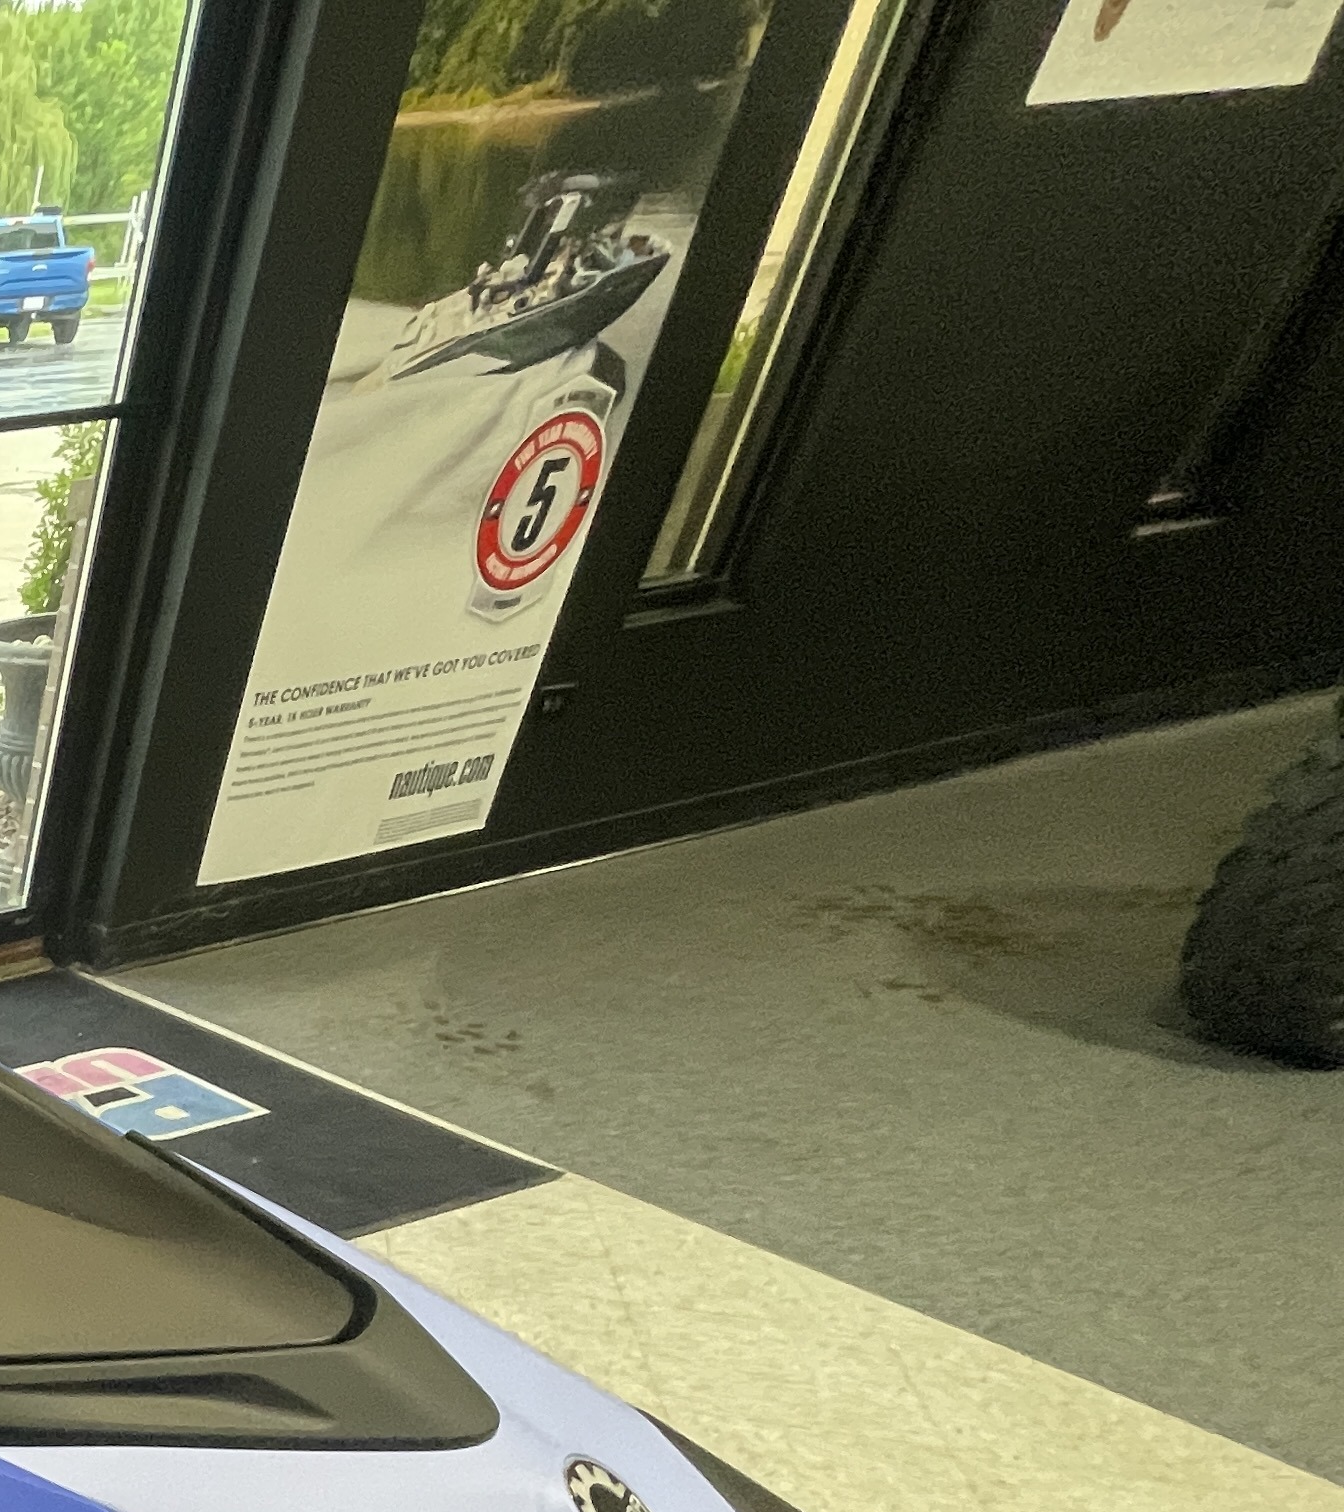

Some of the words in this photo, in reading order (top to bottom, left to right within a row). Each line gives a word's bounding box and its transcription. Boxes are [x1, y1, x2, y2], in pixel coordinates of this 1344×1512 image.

[511, 457, 571, 551] 5
[254, 690, 279, 707] THE
[280, 676, 361, 703] CONFIDENCE
[362, 670, 392, 688] THAT
[394, 663, 431, 683] WE'VE
[433, 658, 460, 676] GOT
[461, 654, 488, 671] YOU
[488, 643, 541, 666] COVERED
[388, 753, 495, 800] nautique.com
